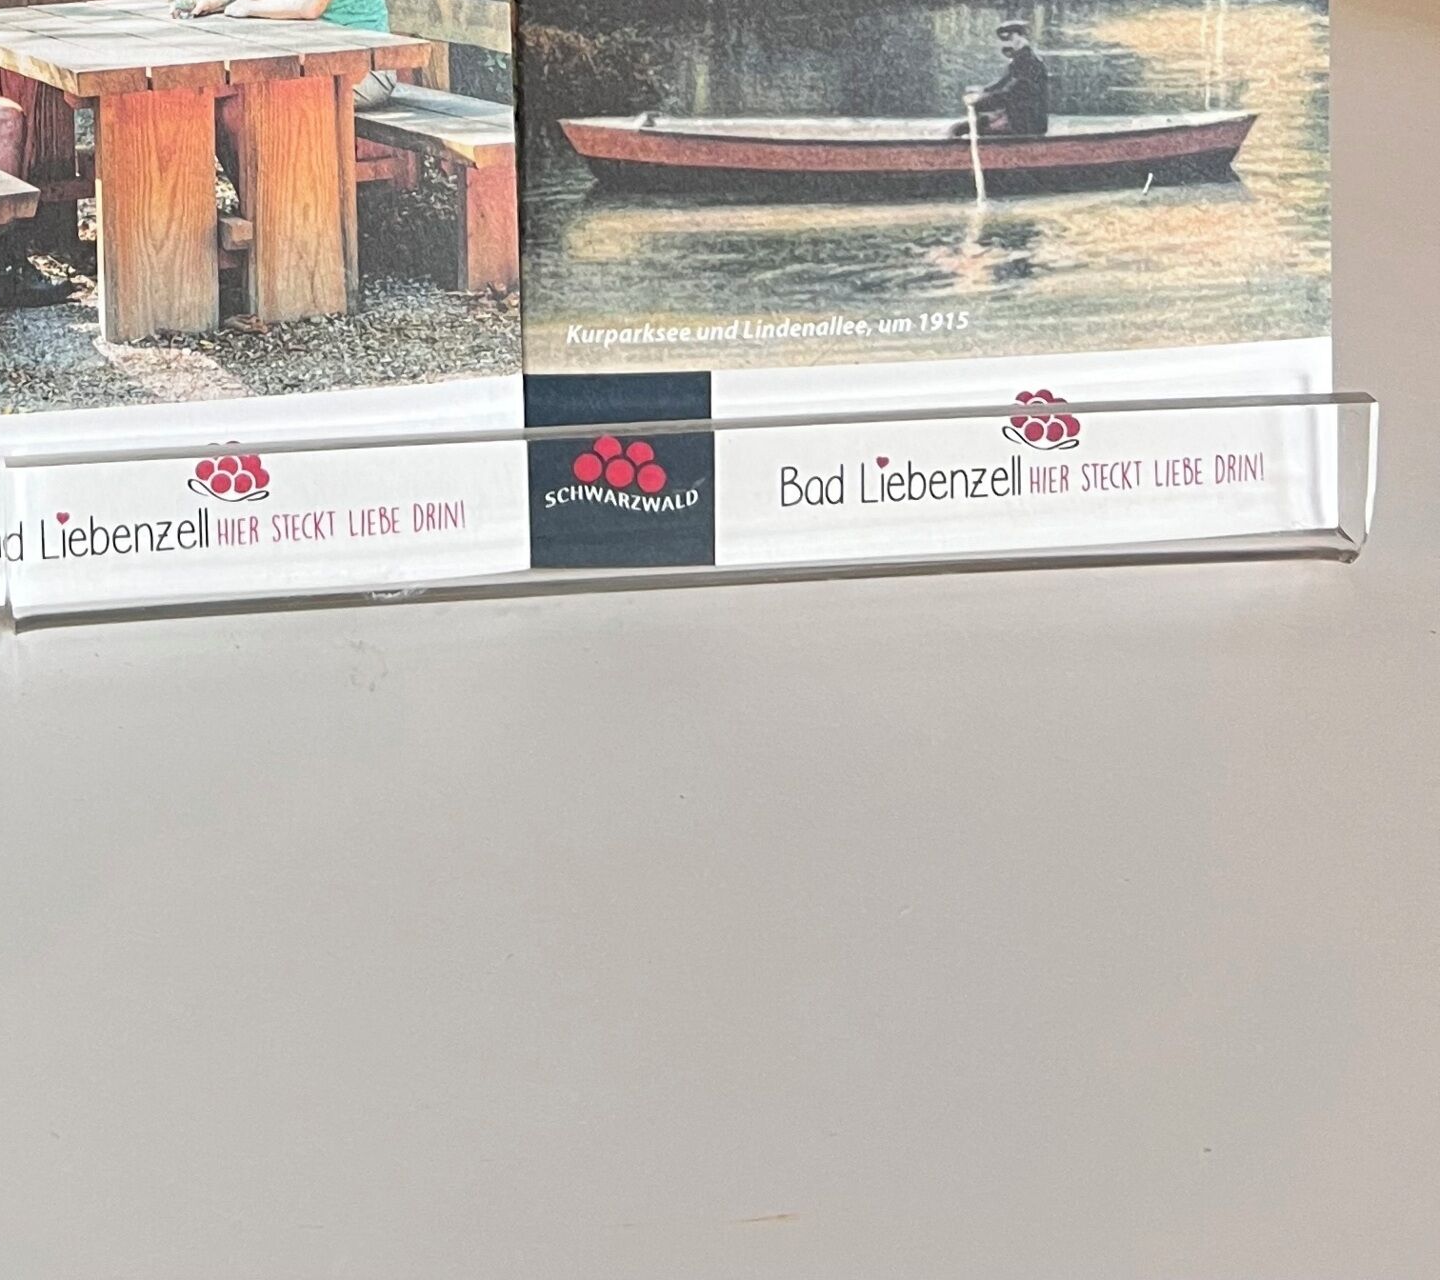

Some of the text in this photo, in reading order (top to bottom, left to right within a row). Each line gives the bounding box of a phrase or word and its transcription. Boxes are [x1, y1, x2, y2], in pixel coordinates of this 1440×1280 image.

[566, 310, 970, 349] Kurparksee und Lindenallee, um 1915
[545, 485, 699, 513] SCHWARZWALD
[780, 451, 1265, 507] Bad Liebenzell HIER STECKT LIEBE DRIN!
[40, 507, 210, 560] Liebenzell
[217, 515, 260, 546] HIER
[271, 510, 336, 543] STECKT
[348, 506, 401, 537] LIEBE
[413, 499, 467, 532] DRIN!
